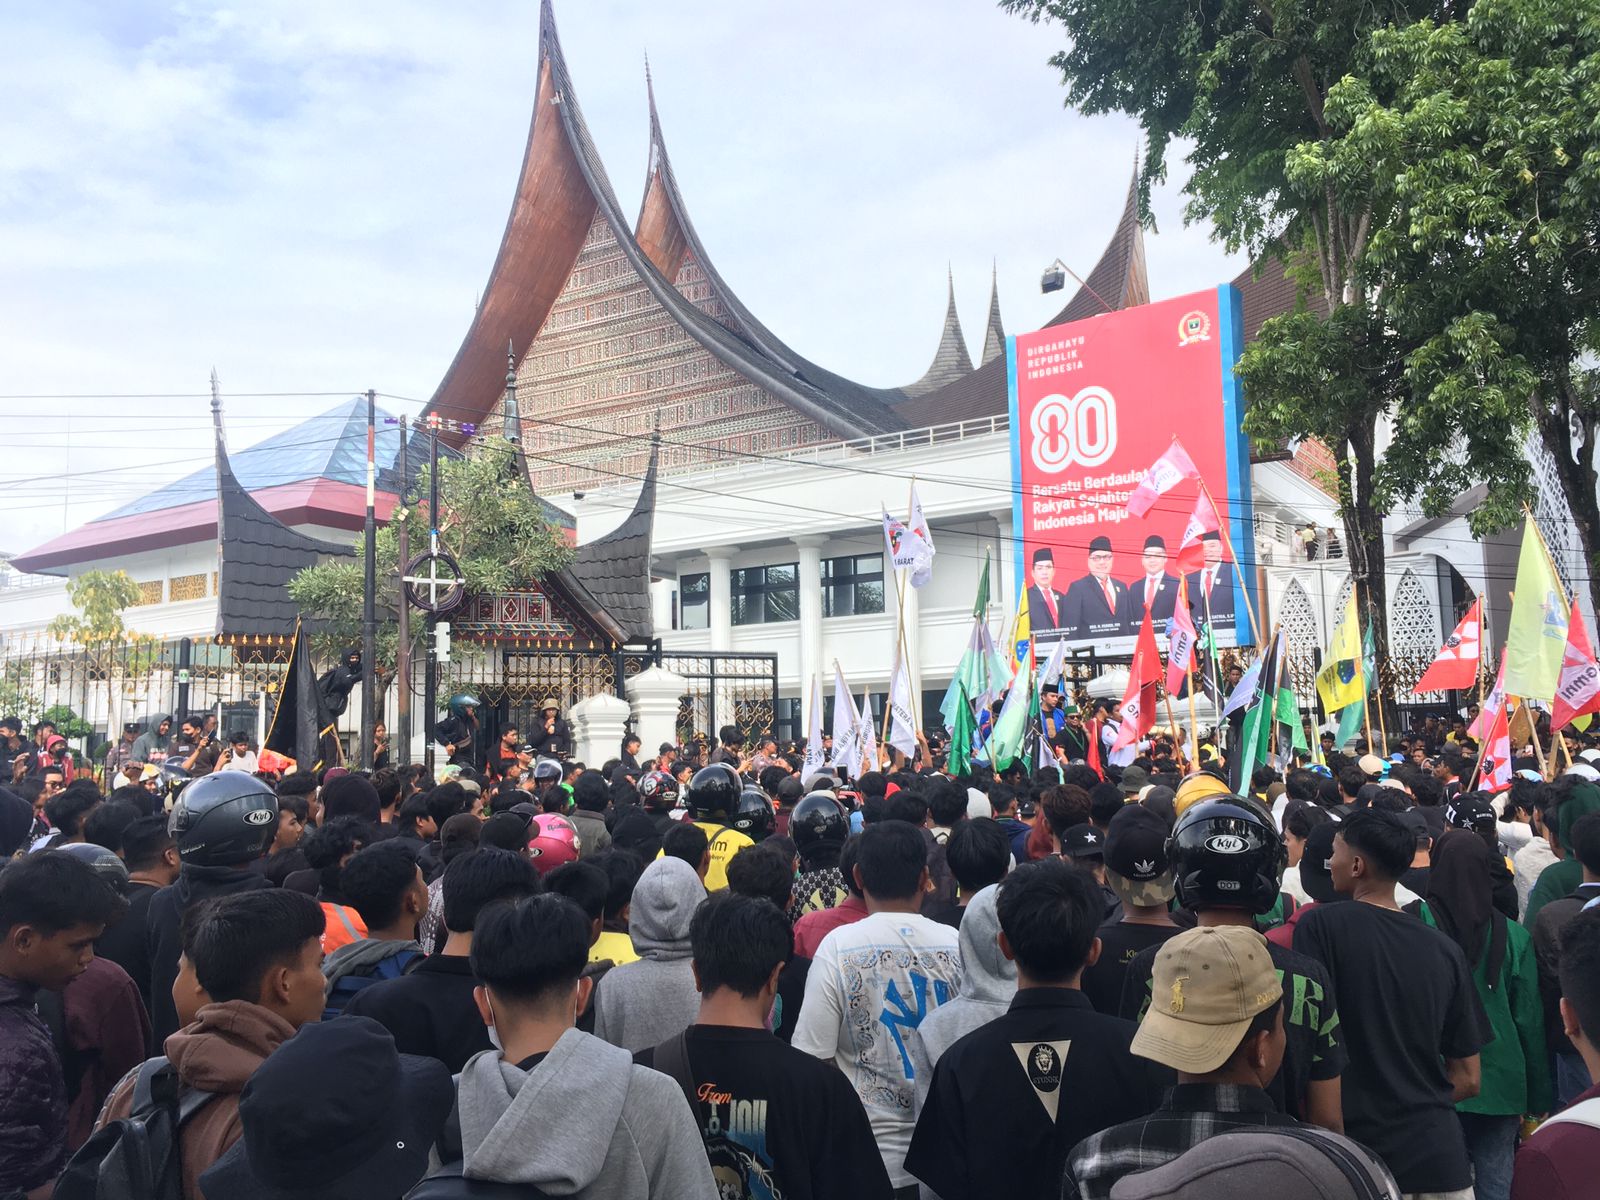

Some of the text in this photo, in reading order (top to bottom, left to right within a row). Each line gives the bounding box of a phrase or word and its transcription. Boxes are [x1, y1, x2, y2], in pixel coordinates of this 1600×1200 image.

[1027, 335, 1085, 357] DIRGAHAYU
[1027, 349, 1078, 368] REPUBLIK
[1028, 360, 1083, 380] INDONESIA
[1030, 386, 1117, 473] 80
[1032, 469, 1148, 498] Bersatu Berdaulat
[1033, 489, 1135, 514] Rakyat Sejahter
[1033, 506, 1129, 531] Indonesia Maju
[897, 557, 914, 566] BARAT
[1220, 881, 1238, 889] DOT
[697, 1082, 732, 1105] From
